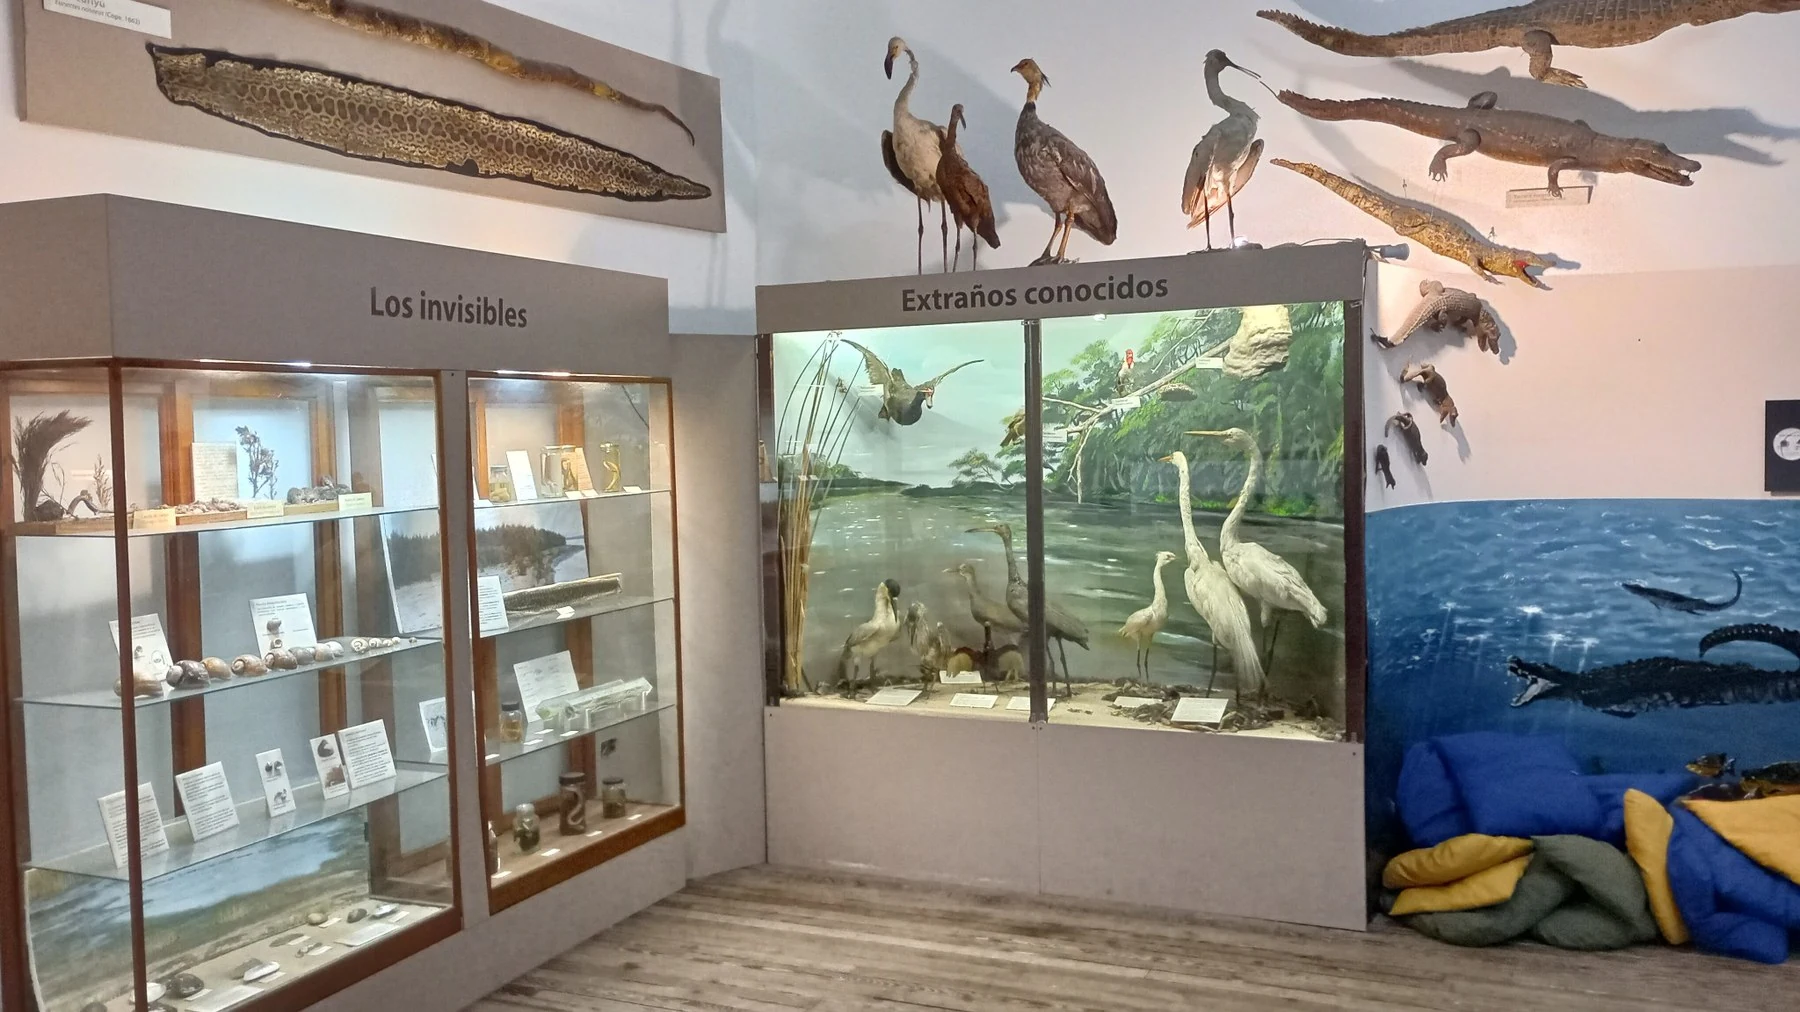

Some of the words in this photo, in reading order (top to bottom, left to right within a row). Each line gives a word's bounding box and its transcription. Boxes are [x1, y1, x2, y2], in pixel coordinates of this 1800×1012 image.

[370, 286, 413, 319] Los
[420, 290, 528, 328] invisibles
[902, 283, 1017, 312] Extraños
[1024, 274, 1169, 305] conocidos
